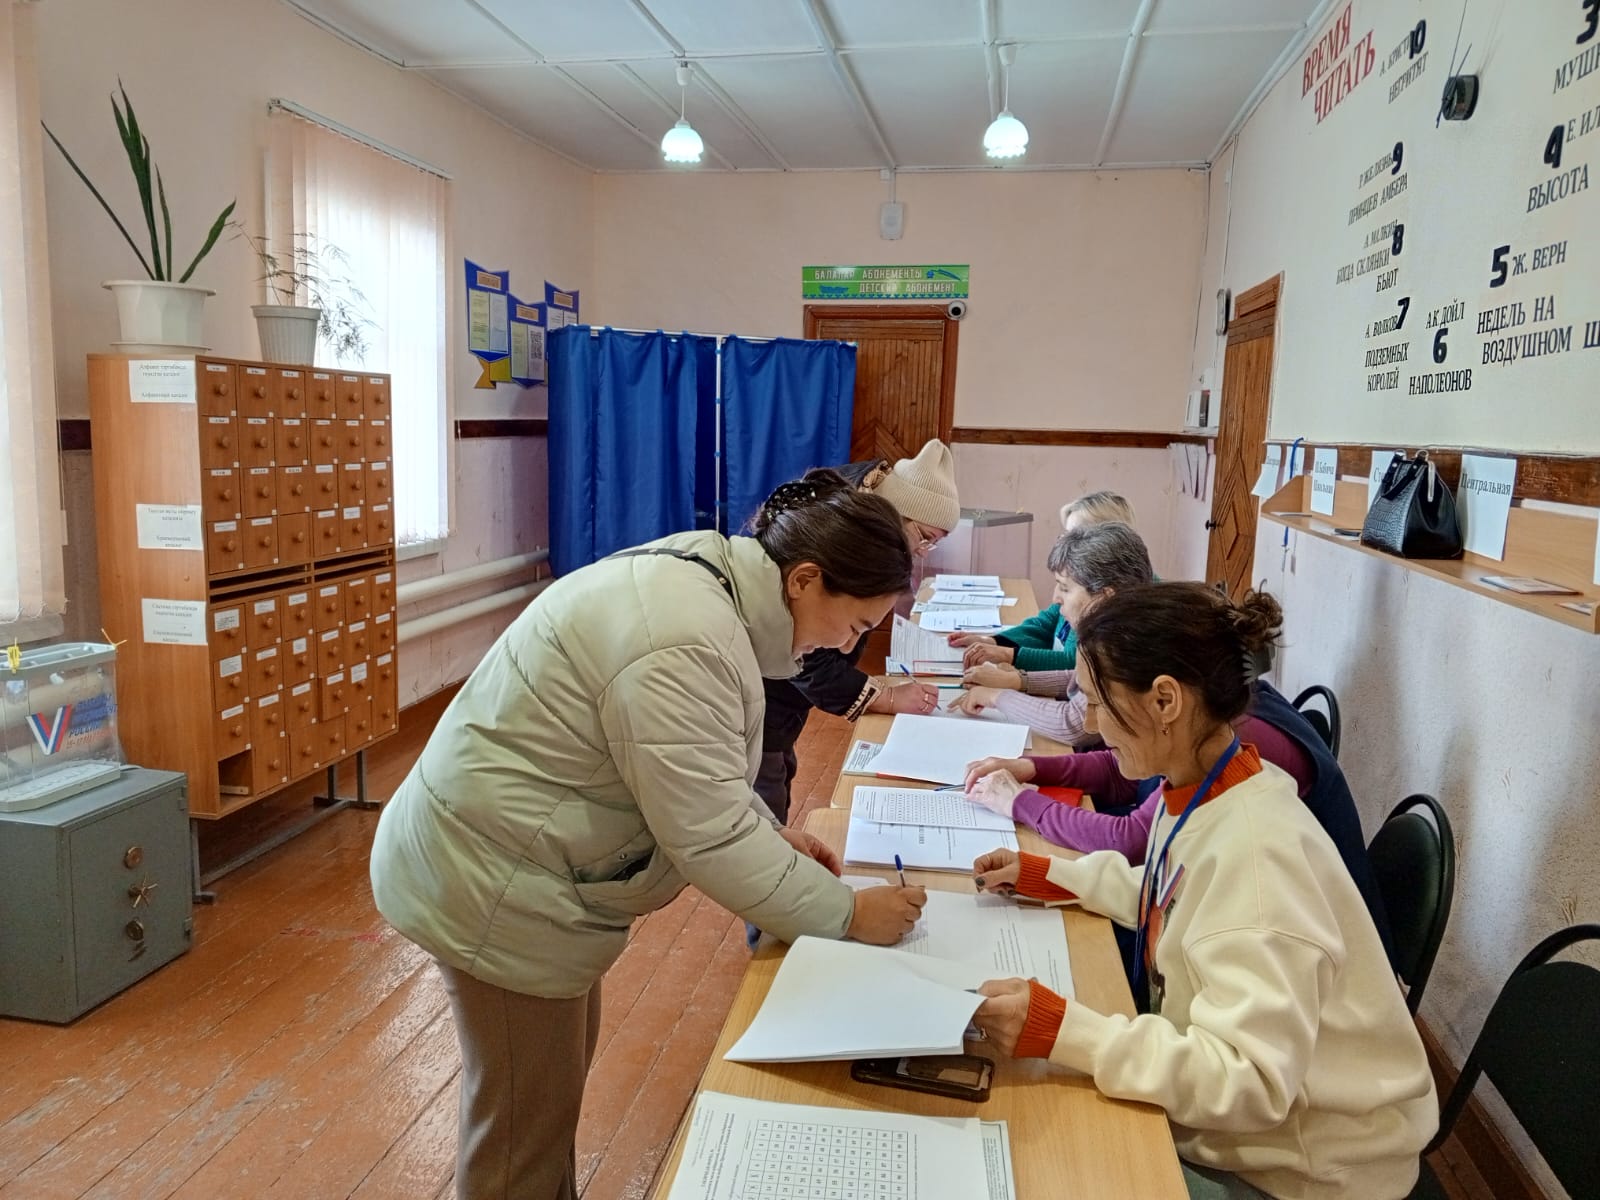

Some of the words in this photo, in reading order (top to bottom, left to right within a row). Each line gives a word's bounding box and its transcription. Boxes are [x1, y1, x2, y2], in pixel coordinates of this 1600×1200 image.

[1301, 1, 1352, 100] ВРЕМЯ
[1409, 19, 1426, 60] 10
[1315, 29, 1375, 125] ЧИТАТЬ
[1391, 141, 1404, 175] 9
[1544, 124, 1565, 169] 4
[1380, 171, 1408, 206] АМБЕРА
[1526, 164, 1589, 214] ВЫСОТА
[1391, 223, 1405, 256] 8
[862, 269, 922, 280] АБОНЕМЕНТЫ
[1356, 247, 1391, 276] СКЛЯНКИ
[1489, 244, 1511, 288] 5
[1512, 252, 1529, 277] Ж.
[1531, 240, 1568, 272] ВЕРН
[859, 282, 898, 294] ДЕТСКИЙ
[905, 282, 956, 294] АБОНЕМЕНТ
[1376, 267, 1400, 293] БЬЮТ
[1398, 296, 1411, 330] 7
[1439, 298, 1466, 329] ДОЙЛ
[1476, 302, 1527, 337] НЕДЕЛЬ
[1533, 295, 1556, 323] НА
[1364, 342, 1410, 370] ПОДЗЕМНЫХ
[1432, 327, 1449, 364] 6
[1482, 325, 1574, 367] ВОЗДУШНОМ
[1366, 366, 1400, 392] КОРОЛЕЙ
[1408, 368, 1473, 396] НАПОЛЕОНОВ
[1460, 472, 1512, 496] Центральная
